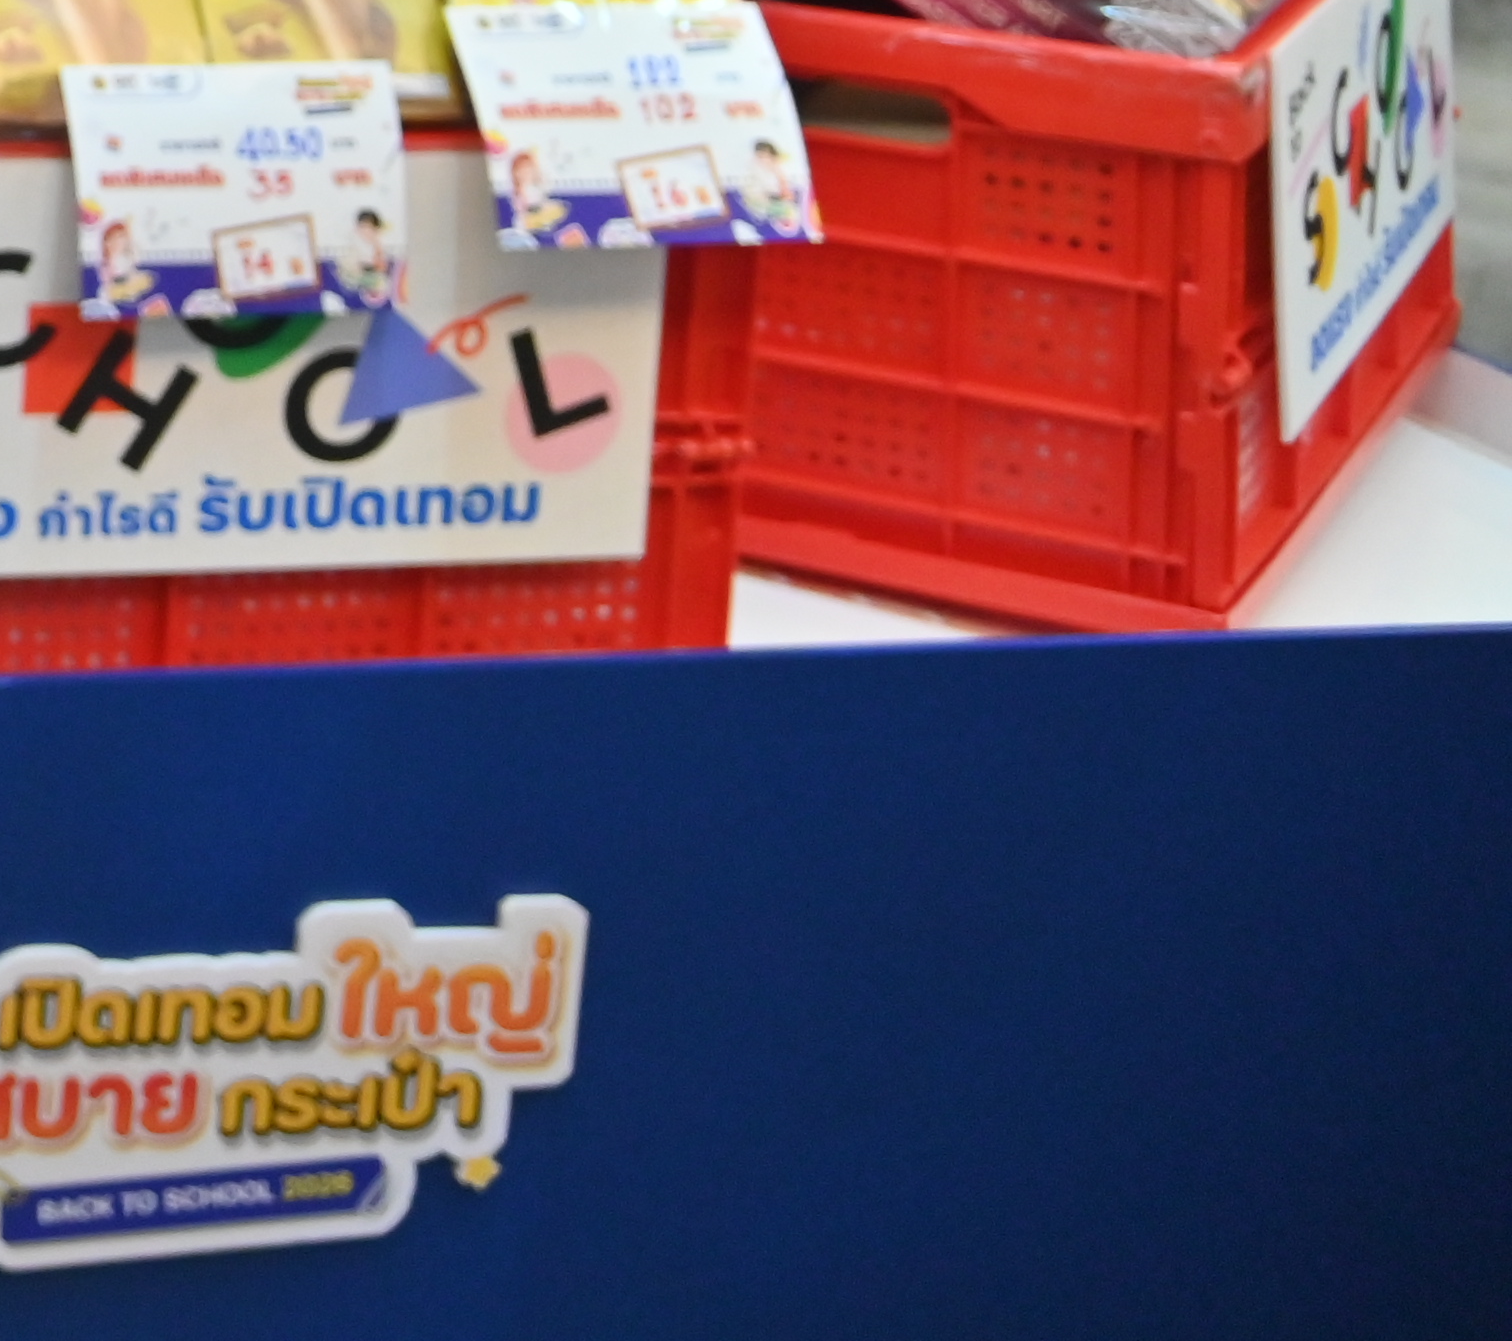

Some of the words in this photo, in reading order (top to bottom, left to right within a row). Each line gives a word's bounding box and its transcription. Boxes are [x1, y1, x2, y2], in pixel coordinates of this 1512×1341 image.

[36, 489, 179, 538] กำไรดี
[197, 474, 541, 534] รับเปิดเทอม
[335, 930, 556, 1055] ใหญ่
[220, 1052, 483, 1135] กระเป๋า
[36, 1192, 115, 1225] BACK
[121, 1189, 159, 1216] TO
[162, 1179, 275, 1213] SCHOOL
[283, 1170, 356, 1200] 2026
